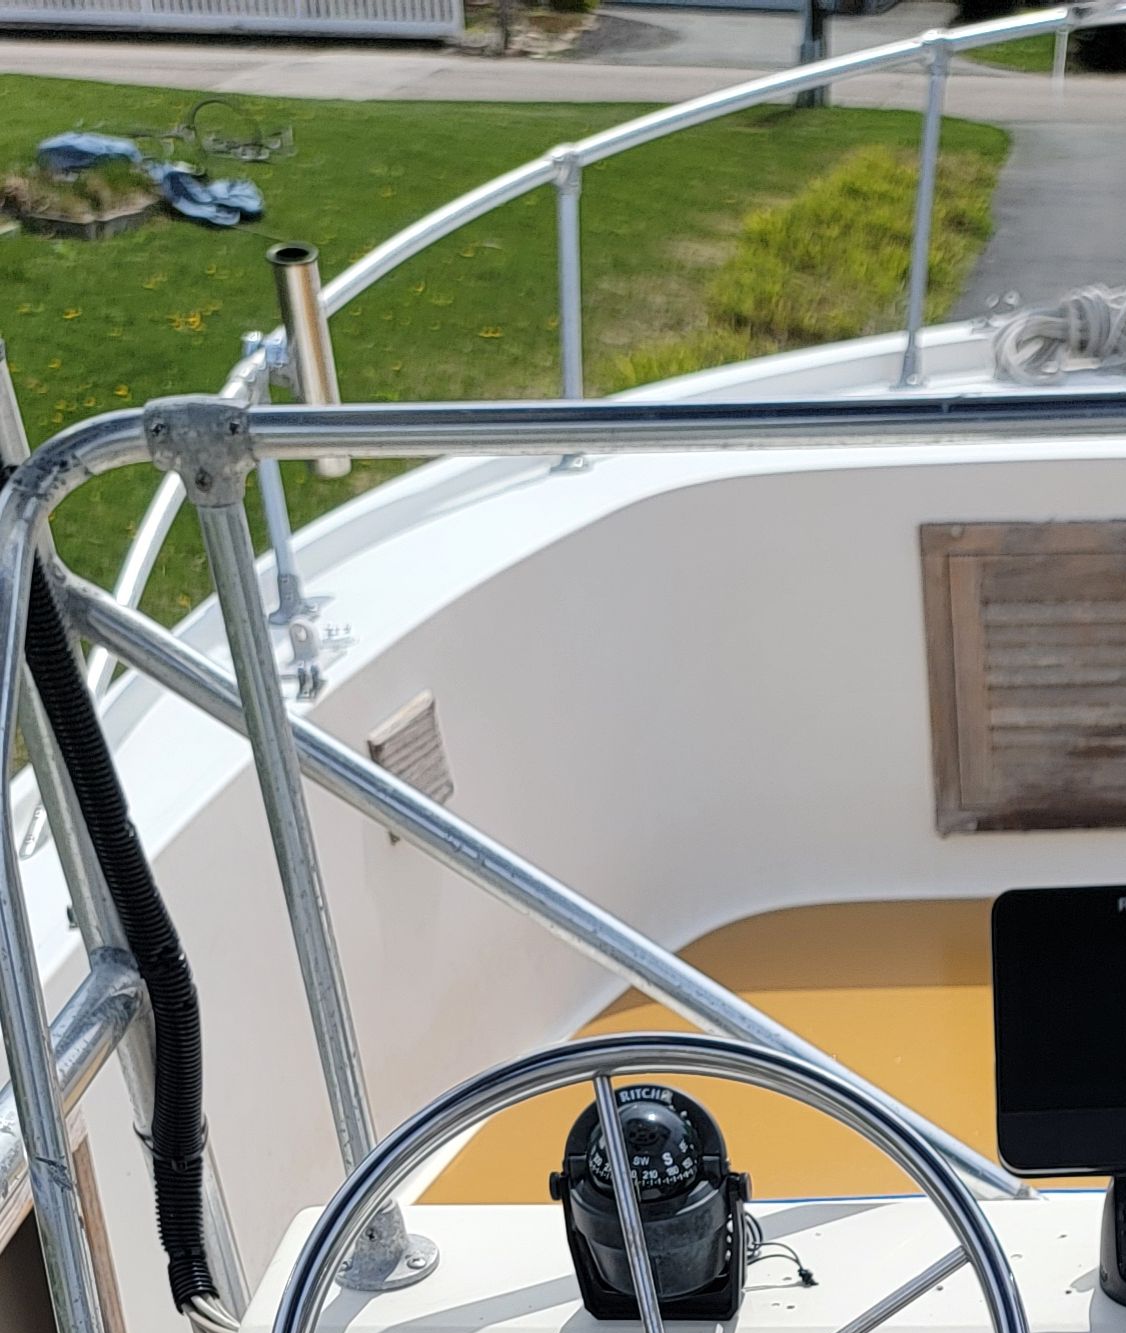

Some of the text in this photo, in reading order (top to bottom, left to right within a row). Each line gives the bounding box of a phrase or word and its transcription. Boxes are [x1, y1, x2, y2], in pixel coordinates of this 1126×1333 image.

[619, 1088, 673, 1104] RITCH
[633, 1156, 650, 1166] SW
[662, 1152, 673, 1166] S
[642, 1170, 658, 1180] 210
